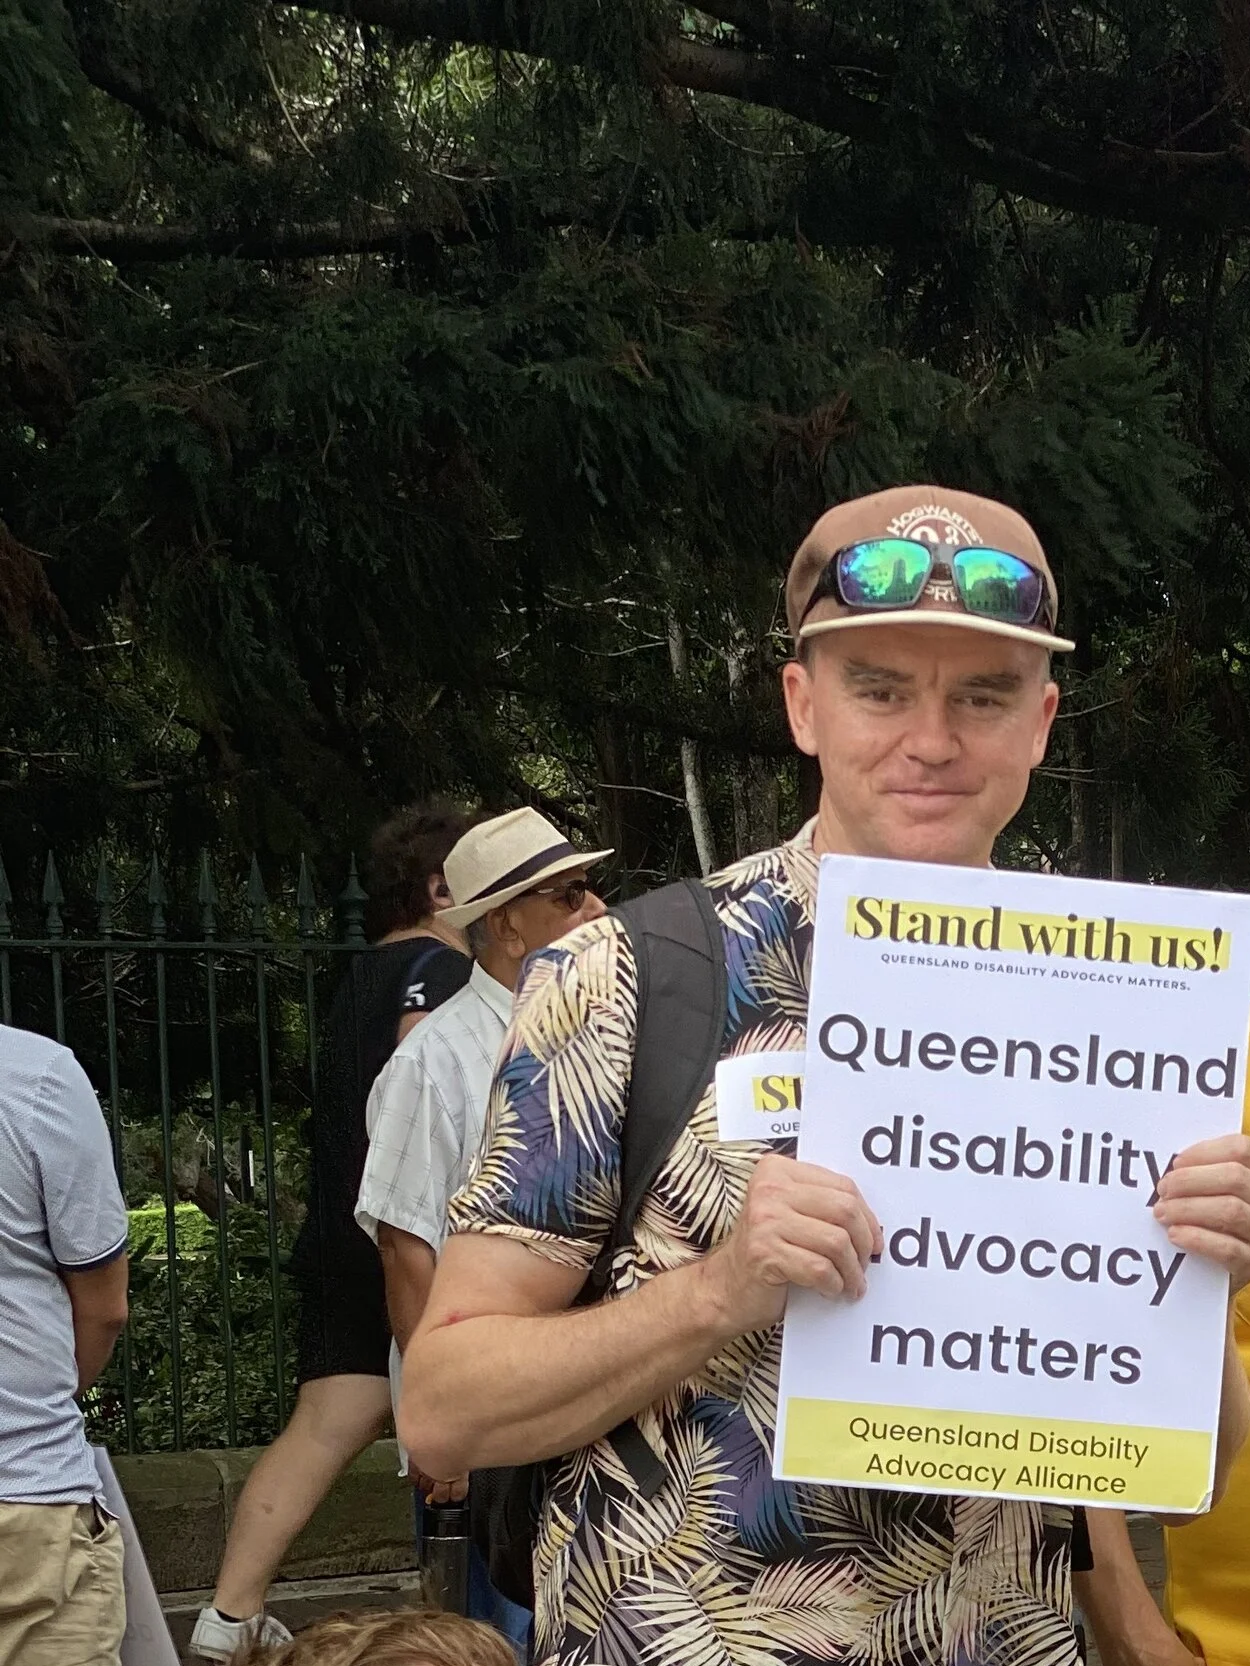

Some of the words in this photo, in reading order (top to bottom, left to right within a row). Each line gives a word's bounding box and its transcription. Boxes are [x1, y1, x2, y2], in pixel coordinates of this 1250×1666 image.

[852, 895, 1003, 953] Stand
[1018, 912, 1132, 965] with
[1149, 927, 1224, 974] us!
[880, 953, 970, 971] QUEENSLAND
[974, 961, 1047, 978] DISABILITY
[1051, 968, 1124, 986] ADVOCACY
[1128, 976, 1191, 991] MATTERS.
[818, 1013, 1238, 1099] Queensland
[861, 1114, 1179, 1207] disability
[870, 1217, 1186, 1306] dvocacy
[870, 1322, 1142, 1385] matters
[849, 1416, 1020, 1450] Queensland
[1029, 1431, 1149, 1467] Disabilty
[865, 1453, 1007, 1490] Advocacy
[1015, 1464, 1127, 1495] Alliance
